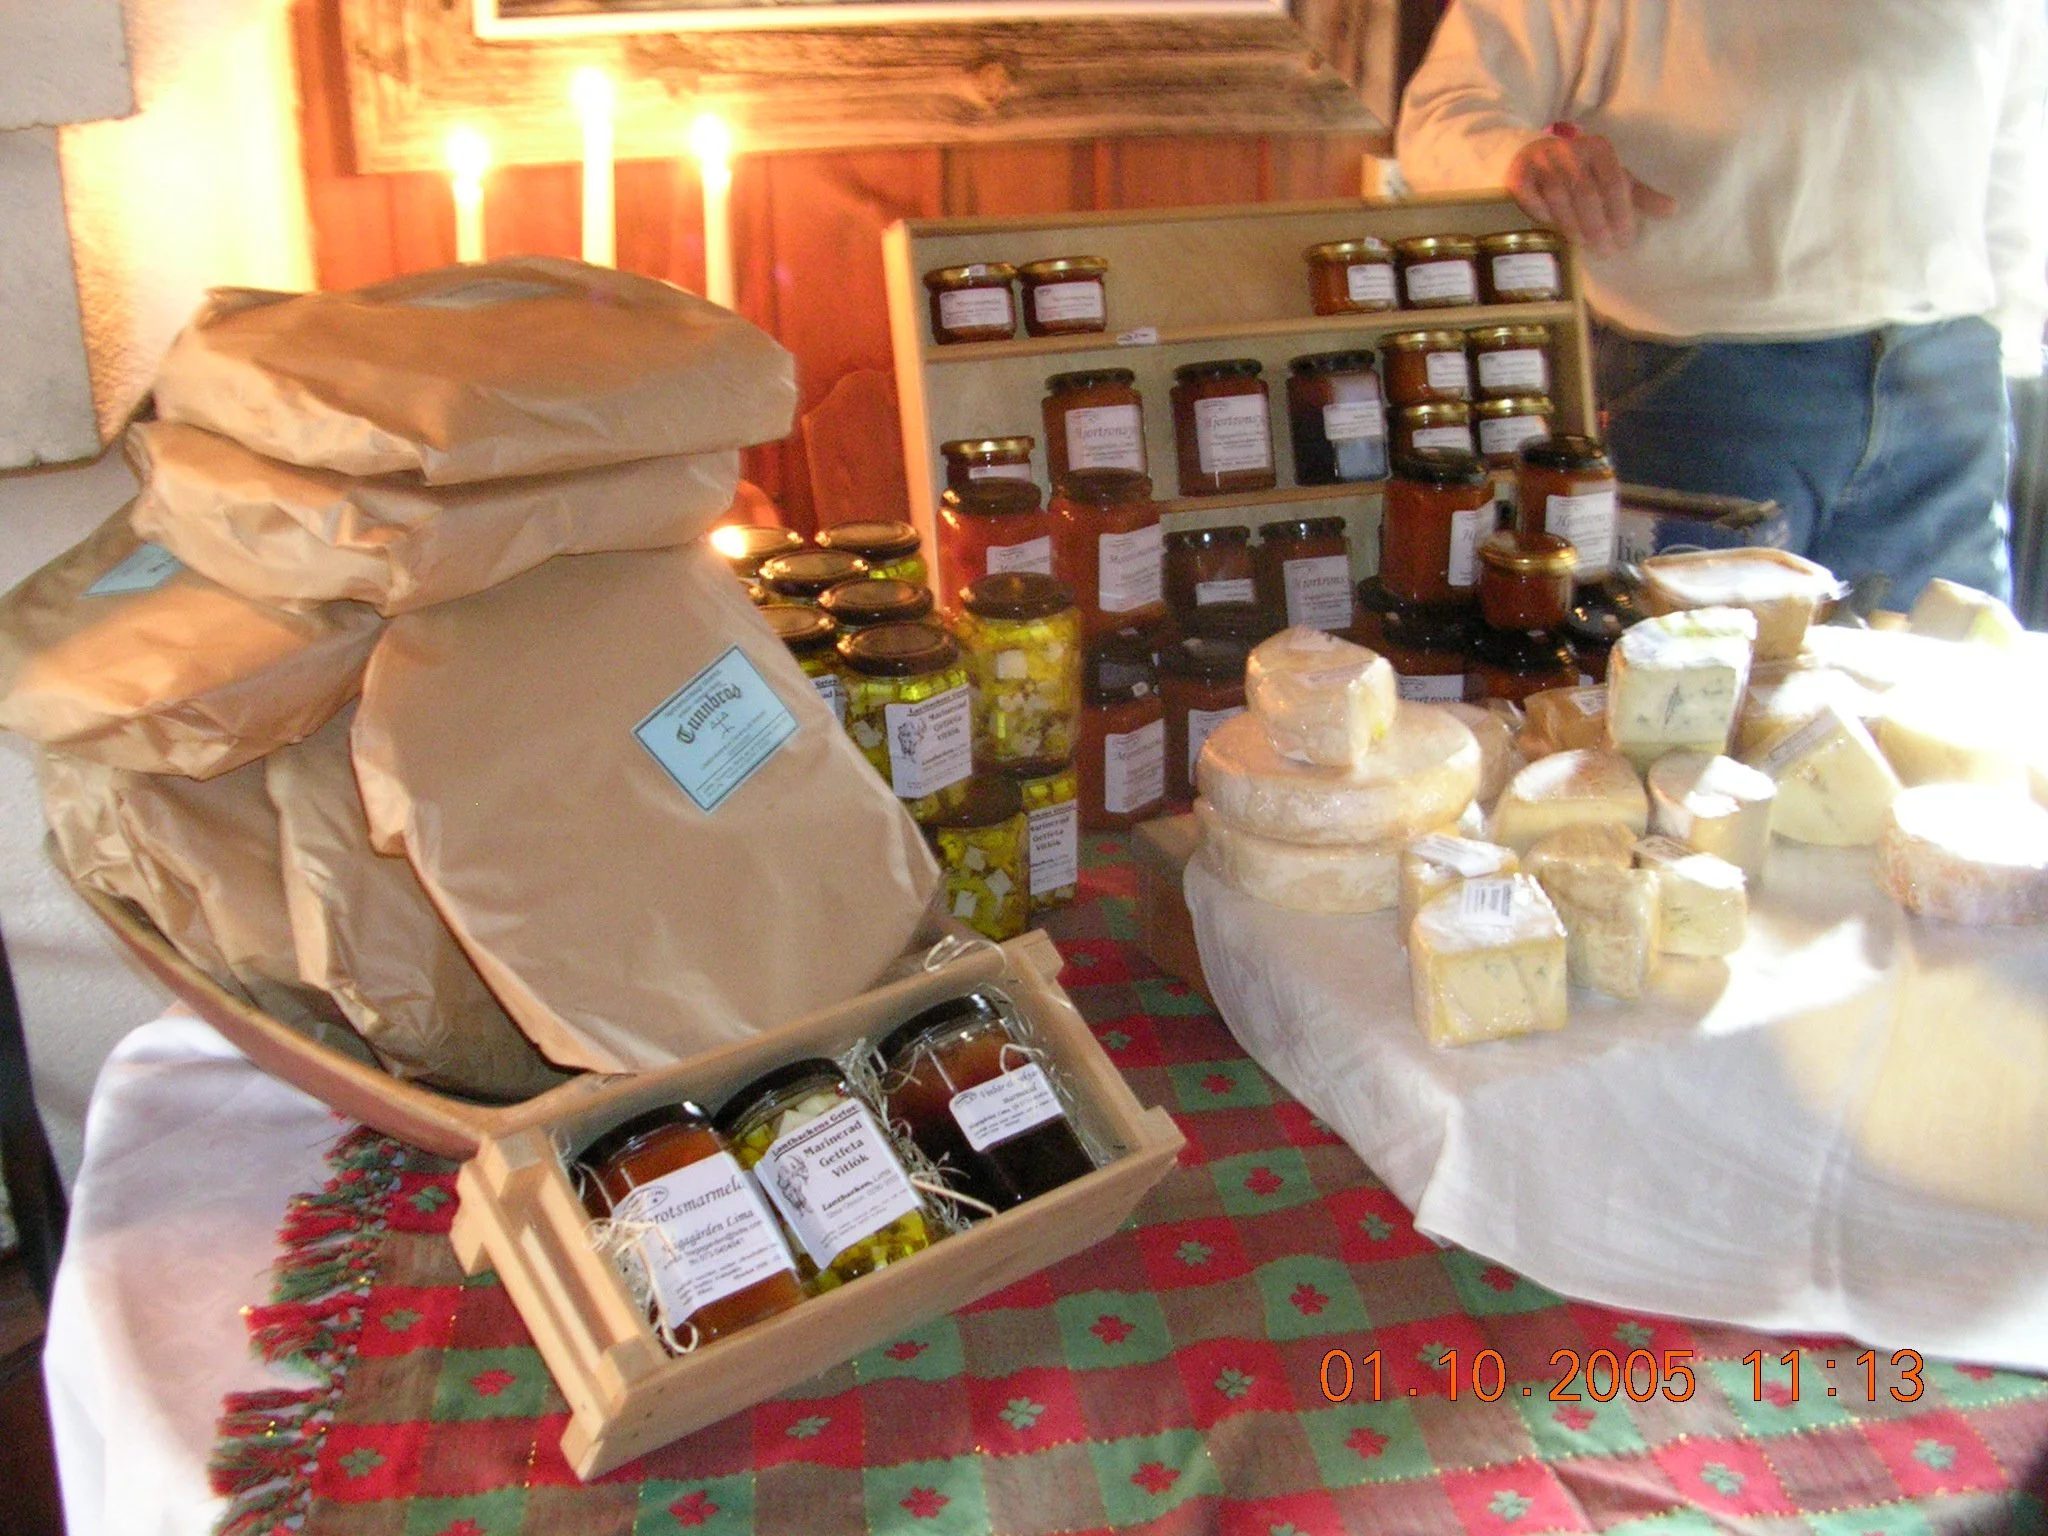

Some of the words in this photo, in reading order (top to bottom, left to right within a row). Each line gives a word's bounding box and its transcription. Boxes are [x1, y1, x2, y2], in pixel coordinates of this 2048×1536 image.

[803, 1119, 863, 1157] Marinerad
[819, 1138, 865, 1169] Getfeta
[726, 1209, 754, 1227] Lima
